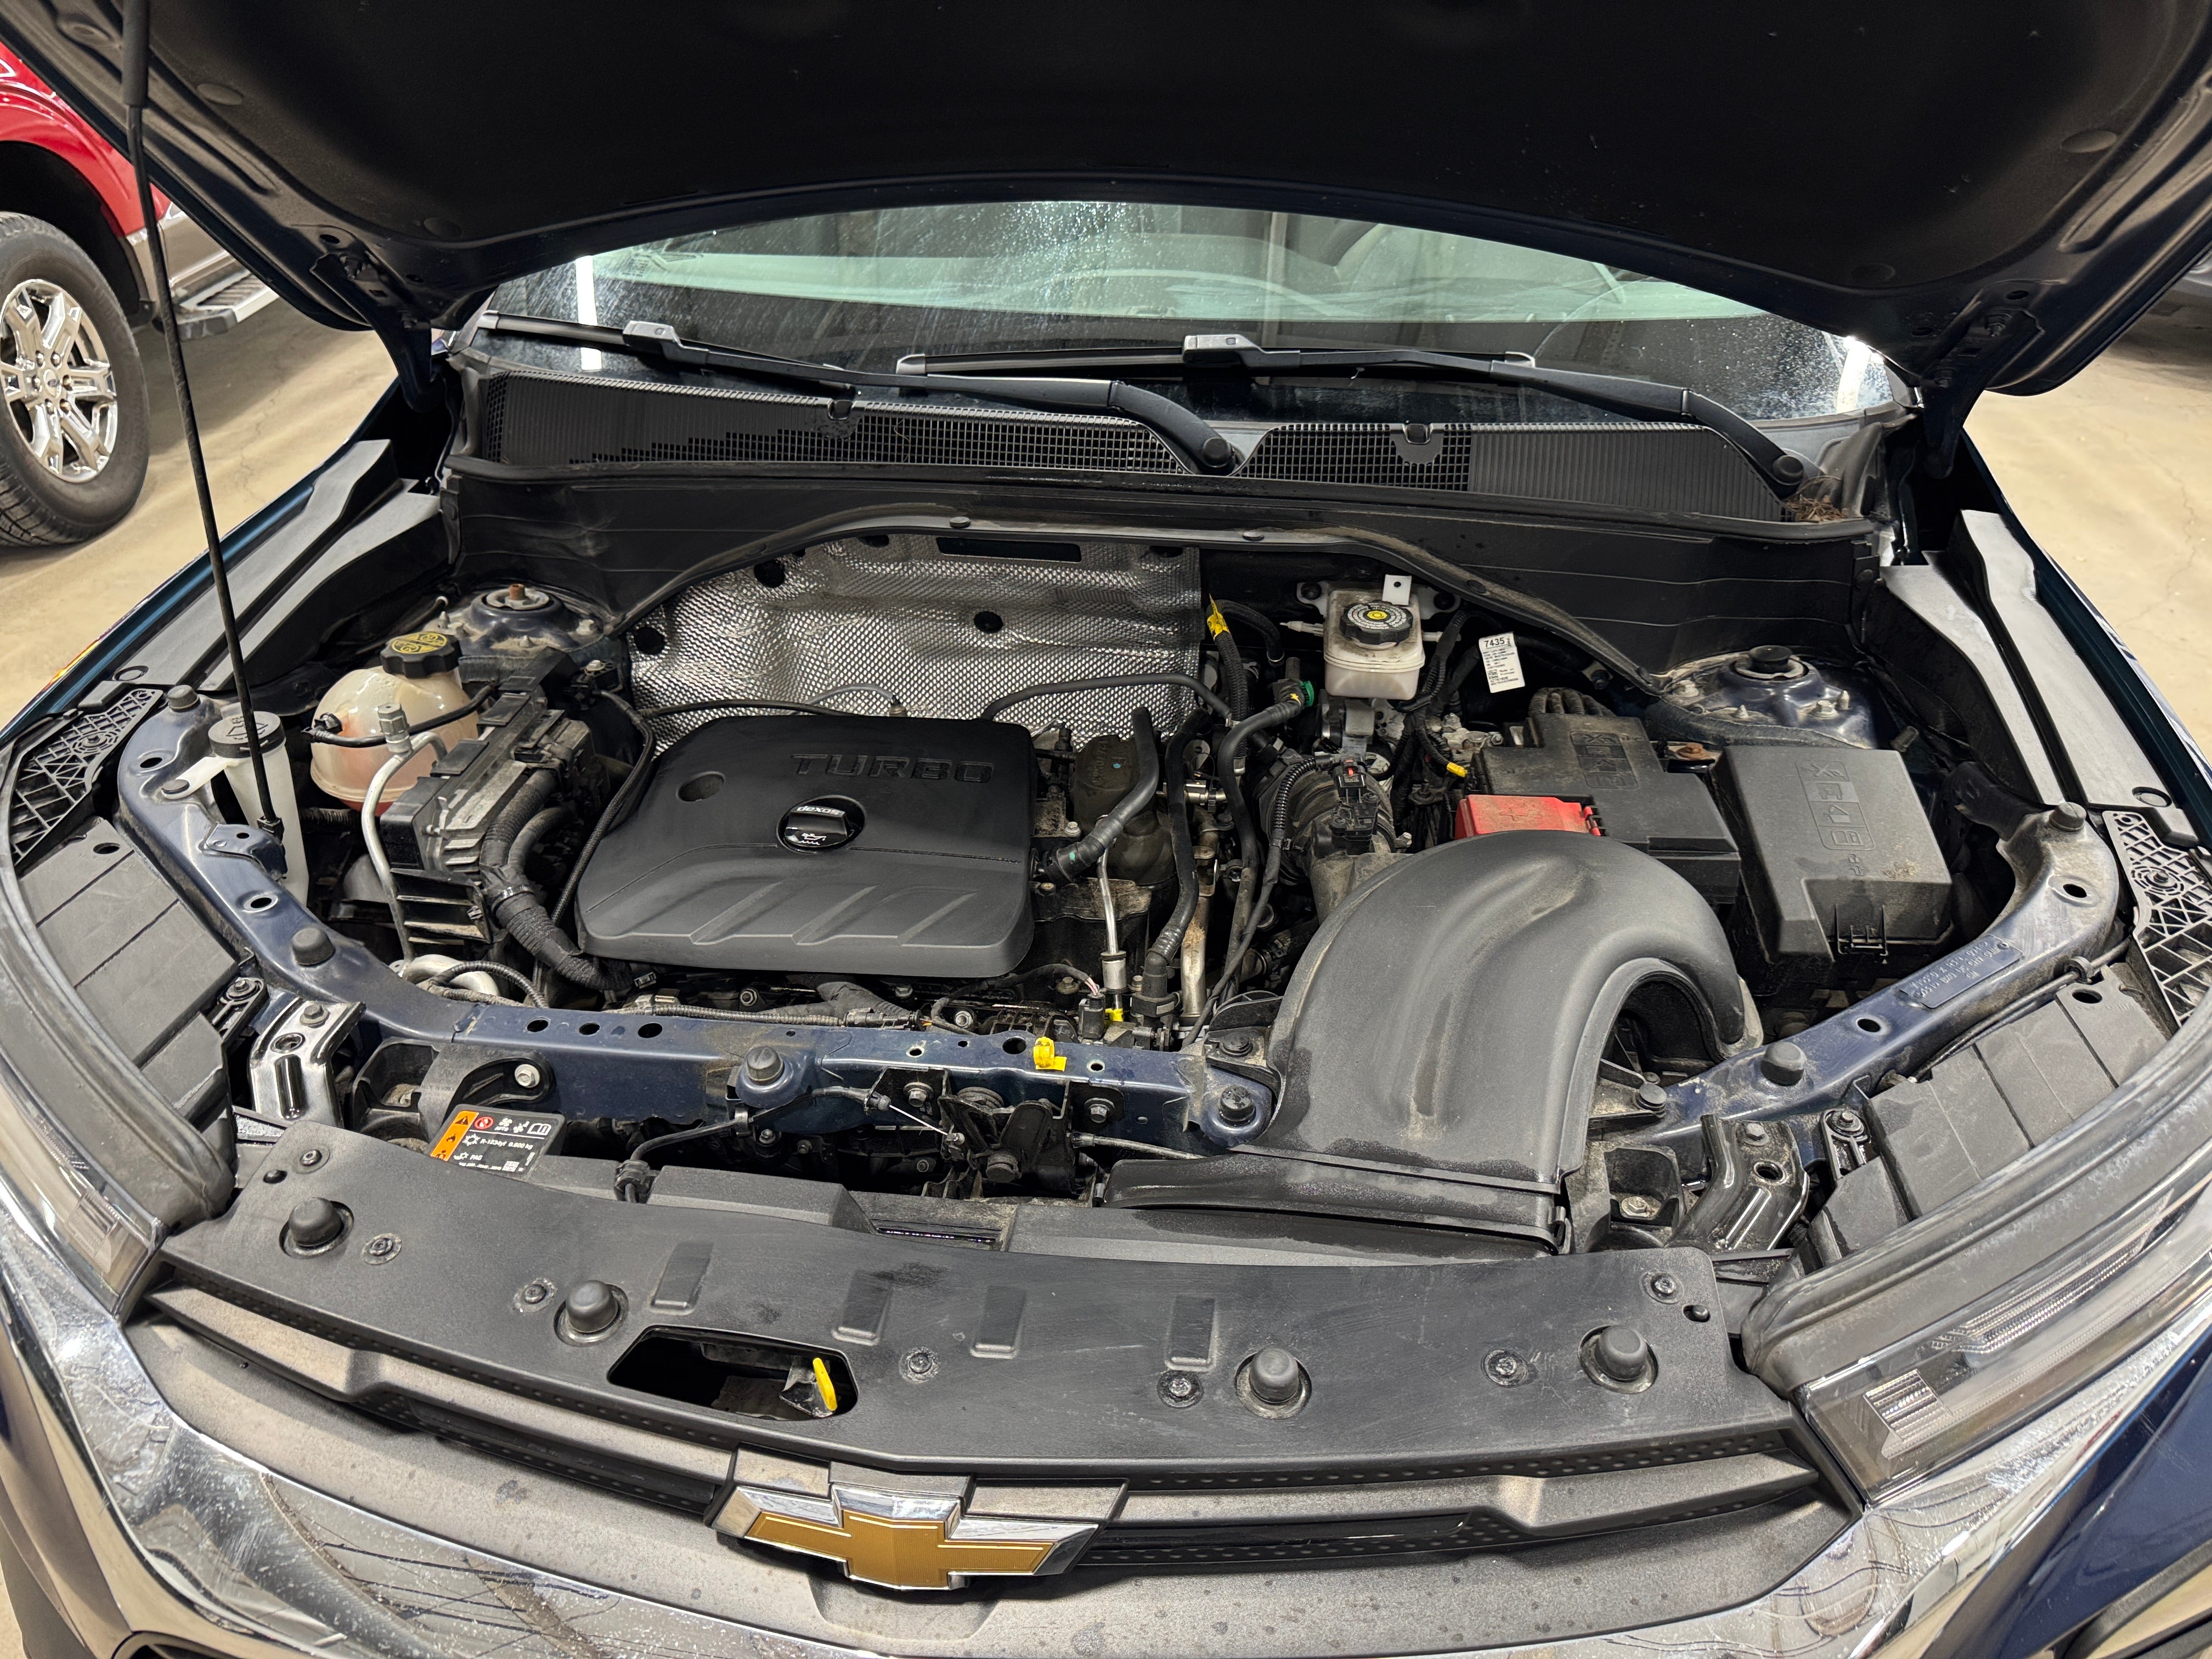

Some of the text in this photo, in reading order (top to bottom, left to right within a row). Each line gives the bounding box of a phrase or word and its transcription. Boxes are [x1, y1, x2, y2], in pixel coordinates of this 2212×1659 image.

[1483, 637, 1505, 647] 7435
[791, 754, 995, 783] TURBO
[797, 805, 840, 815] dexos
